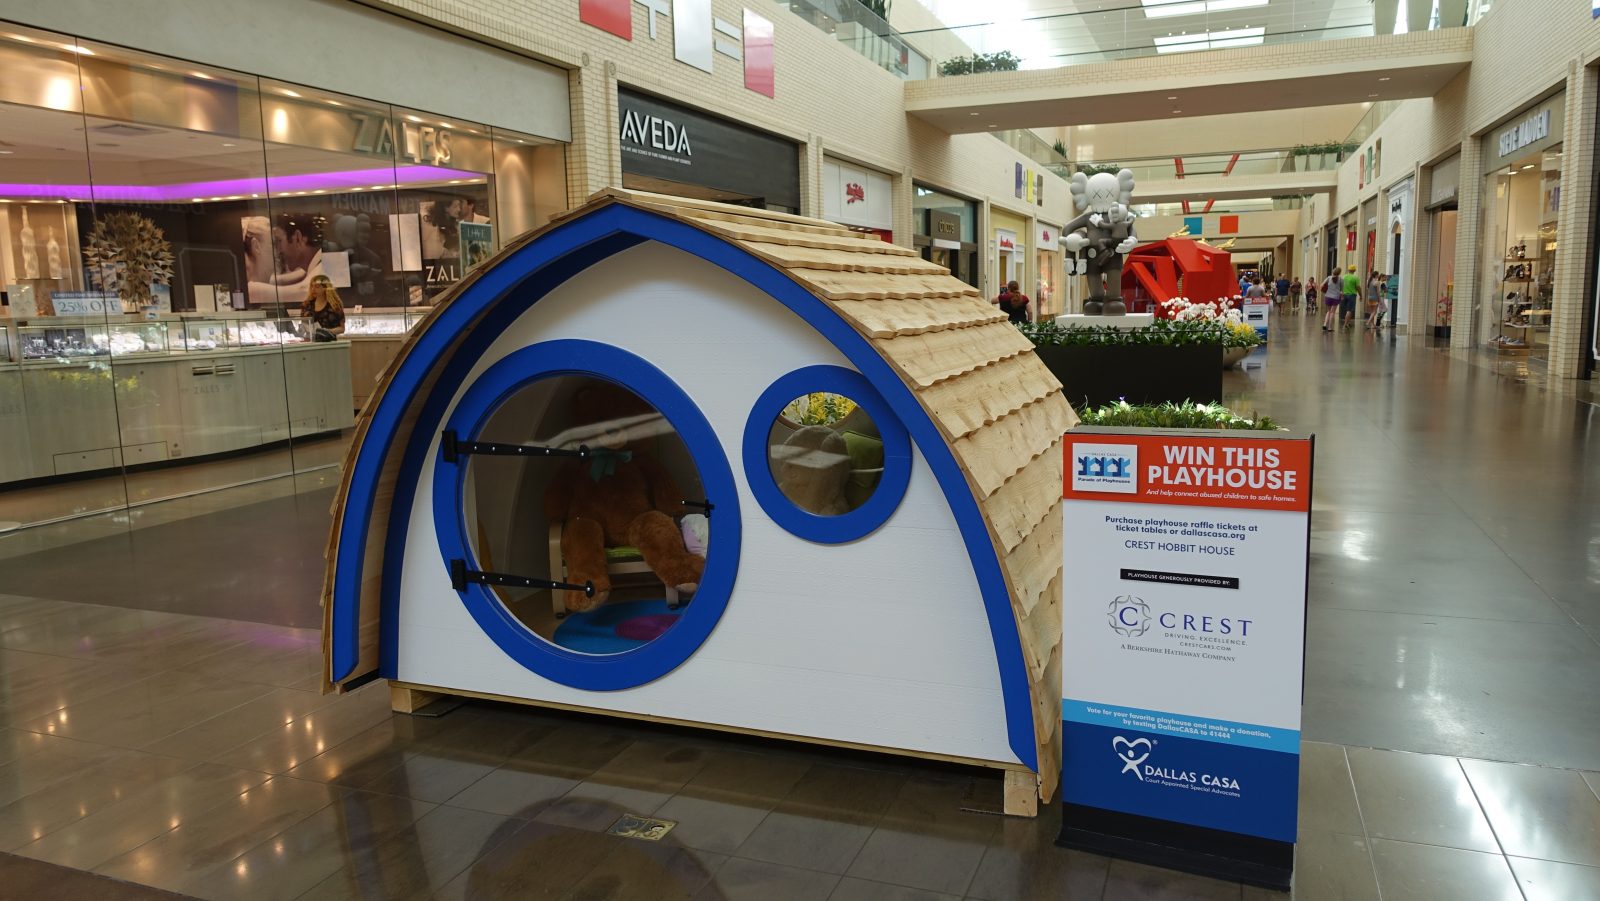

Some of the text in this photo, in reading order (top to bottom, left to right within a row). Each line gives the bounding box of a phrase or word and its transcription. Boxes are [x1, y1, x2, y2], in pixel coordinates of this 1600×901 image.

[349, 112, 451, 164] ZALES
[621, 109, 692, 156] AVEDA
[426, 265, 460, 282] ZAL
[58, 300, 88, 313] 25%
[1163, 445, 1280, 469] WIN THIS
[1147, 465, 1297, 491] PLAYHOUSE
[1160, 489, 1173, 497] help
[1200, 491, 1222, 499] abused
[1223, 492, 1249, 500] children
[1105, 515, 1143, 525] Purchase
[1144, 517, 1188, 528] playhouse
[1190, 520, 1214, 530] raffle
[1216, 522, 1246, 532] tickets
[1115, 524, 1246, 541] ticket tables or dallascasa.org
[1124, 539, 1236, 556] CREST HOBBIT HOUSE
[1127, 572, 1159, 580] PLAYHOUSE
[1159, 574, 1193, 583] GENEROUSLY
[1193, 577, 1222, 585] PROVIDED
[1119, 606, 1138, 627] C
[1159, 612, 1253, 636] CREST
[1179, 641, 1232, 651] CRESTCARS.COM
[1086, 706, 1101, 714] Vote
[1102, 708, 1112, 716] for
[1129, 713, 1155, 722] favorite
[1156, 716, 1192, 727] playhouse
[1208, 724, 1228, 732] make
[1123, 718, 1231, 739] by texting DallasCASA to 41444
[1144, 776, 1240, 798] Court Appointed Special Advocates
[1145, 765, 1240, 790] DALLAS CASA
